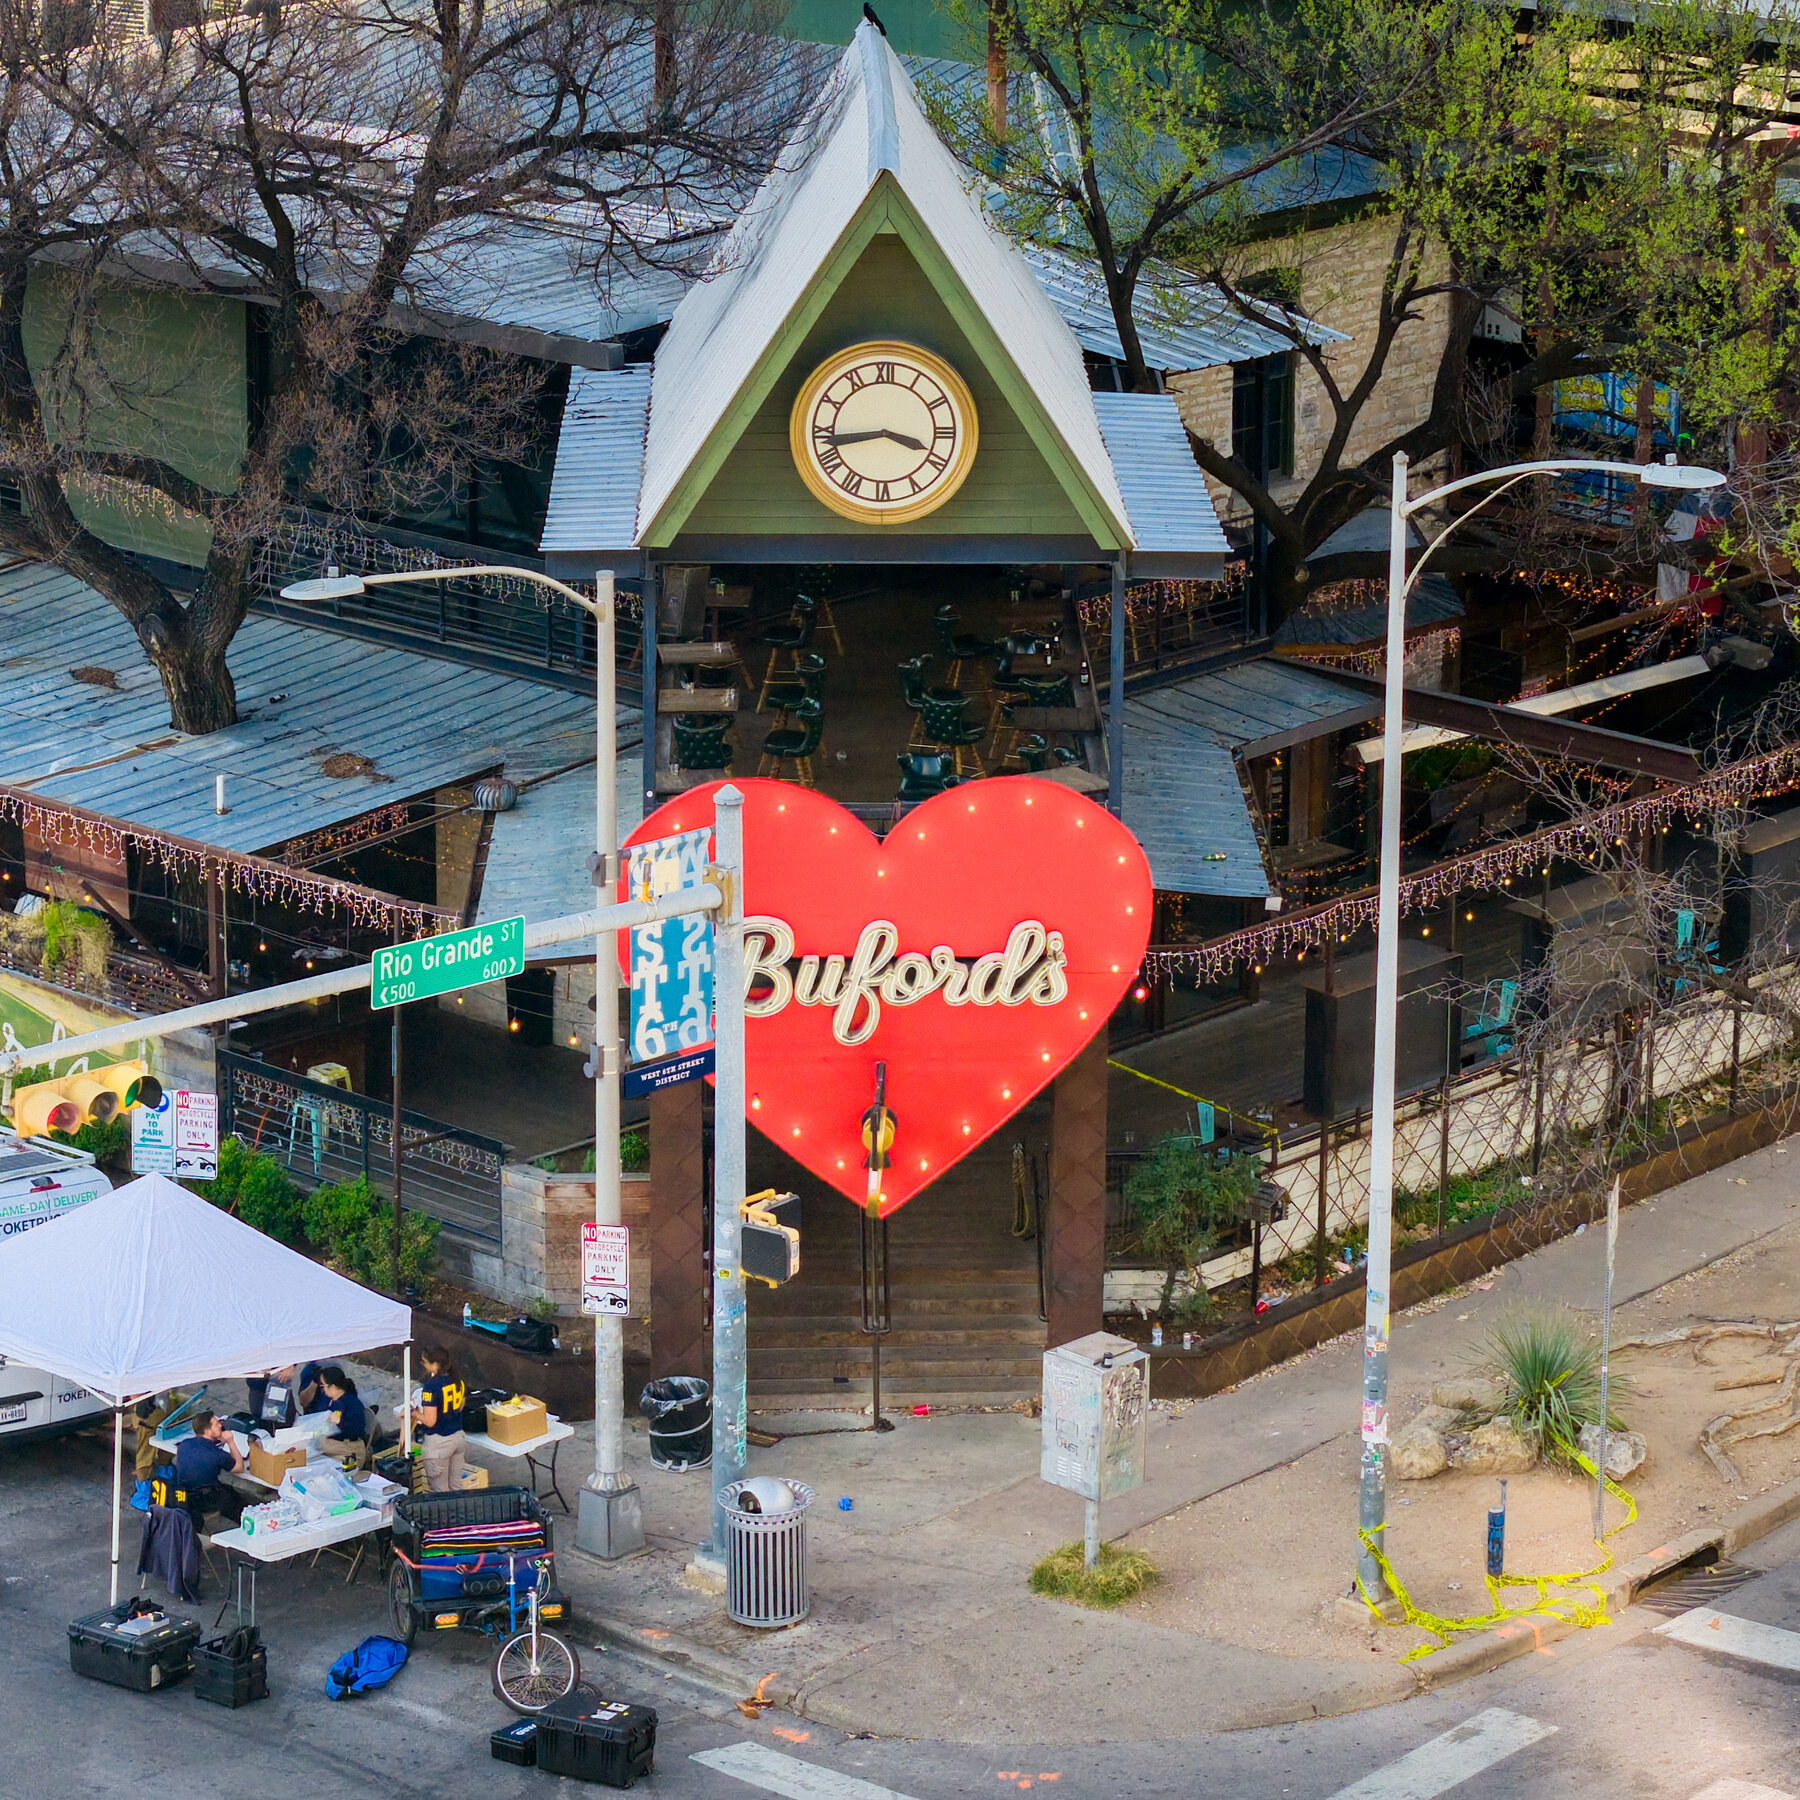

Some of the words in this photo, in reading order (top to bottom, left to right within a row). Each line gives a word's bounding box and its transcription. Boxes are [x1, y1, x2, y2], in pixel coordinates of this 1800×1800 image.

[876, 363, 895, 383] XII
[935, 426, 954, 439] III
[380, 950, 412, 981] Rio
[422, 931, 494, 970] Grande
[501, 921, 518, 942] ST
[390, 981, 415, 1002] 500
[483, 959, 507, 979] 600
[743, 915, 1068, 1046] Buford's
[640, 1070, 661, 1081] WEST
[662, 1065, 677, 1075] 6TH
[678, 1057, 705, 1070] STREET
[655, 1070, 690, 1086] DISTRICT
[177, 1093, 188, 1107] NO
[189, 1096, 215, 1106] PARKING
[145, 1112, 161, 1120] PAY
[179, 1110, 214, 1119] MOTORCYCLE
[148, 1120, 158, 1128] TO
[180, 1119, 213, 1129] PARKING
[142, 1128, 164, 1136] PARK
[186, 1130, 206, 1140] ONLY
[54, 1190, 98, 1207] DELIVERY
[584, 1227, 596, 1240] NO
[597, 1229, 625, 1240] PARKING
[585, 1243, 625, 1253] MOTORCYCLE
[587, 1252, 624, 1262] PARKING
[595, 1265, 616, 1274] ONLY
